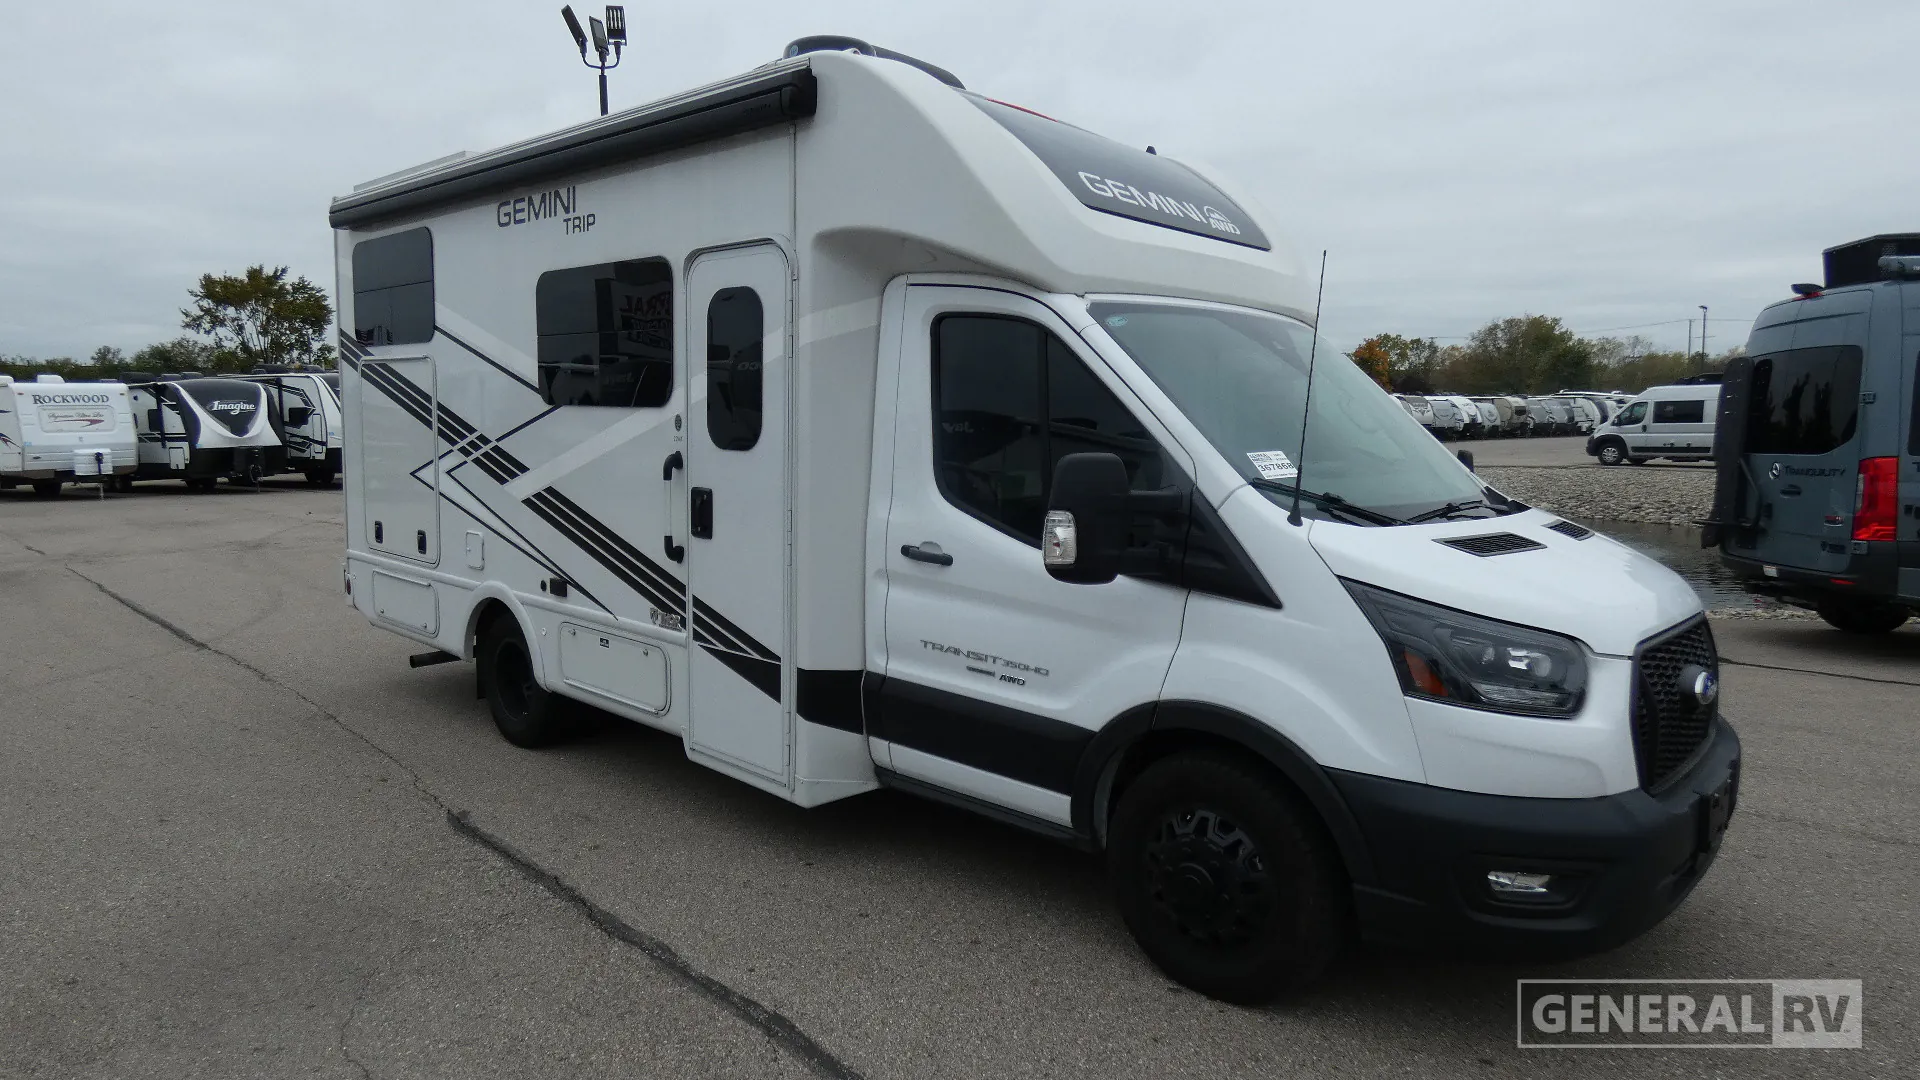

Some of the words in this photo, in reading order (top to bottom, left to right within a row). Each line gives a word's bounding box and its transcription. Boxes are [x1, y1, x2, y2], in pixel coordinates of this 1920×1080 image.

[497, 185, 577, 228] GEMINI
[1078, 170, 1208, 224] GEMINI
[1208, 217, 1241, 235] AWD
[563, 213, 596, 236] TRIP
[32, 394, 110, 405] ROCKWOOD
[211, 400, 256, 415] Imagine
[1257, 462, 1295, 472] 367868
[920, 639, 1003, 665] TRANSIT
[999, 674, 1026, 687] AWD
